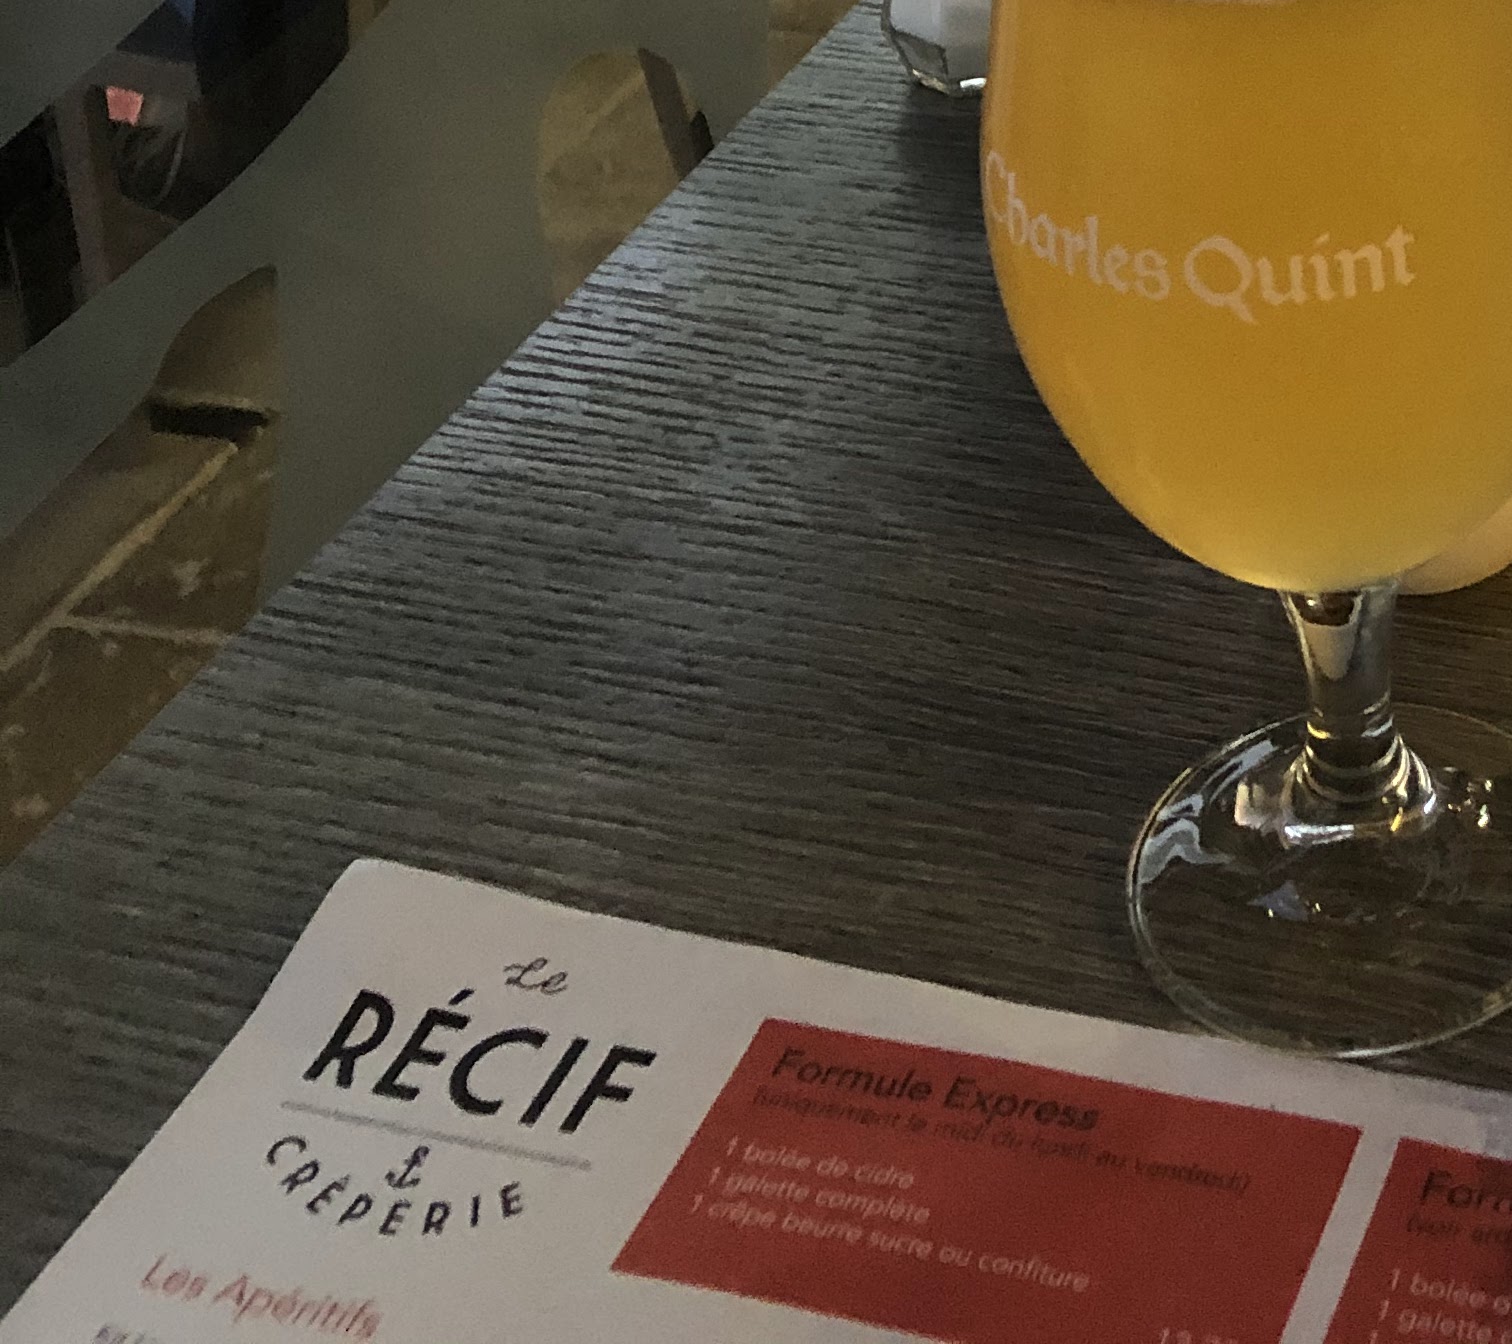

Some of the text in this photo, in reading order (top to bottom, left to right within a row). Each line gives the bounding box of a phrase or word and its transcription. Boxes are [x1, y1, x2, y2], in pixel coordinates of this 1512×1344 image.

[985, 150, 1416, 326] Charles Quint
[503, 957, 569, 996] Le
[303, 987, 658, 1135] RÉCIF
[771, 1046, 1098, 1132] Formule Express
[726, 1135, 739, 1156] 1
[709, 1166, 721, 1186] 1
[692, 1194, 703, 1212] 1
[141, 1253, 208, 1301] Les
[1391, 1267, 1400, 1292] 1
[1380, 1299, 1390, 1321] 1
